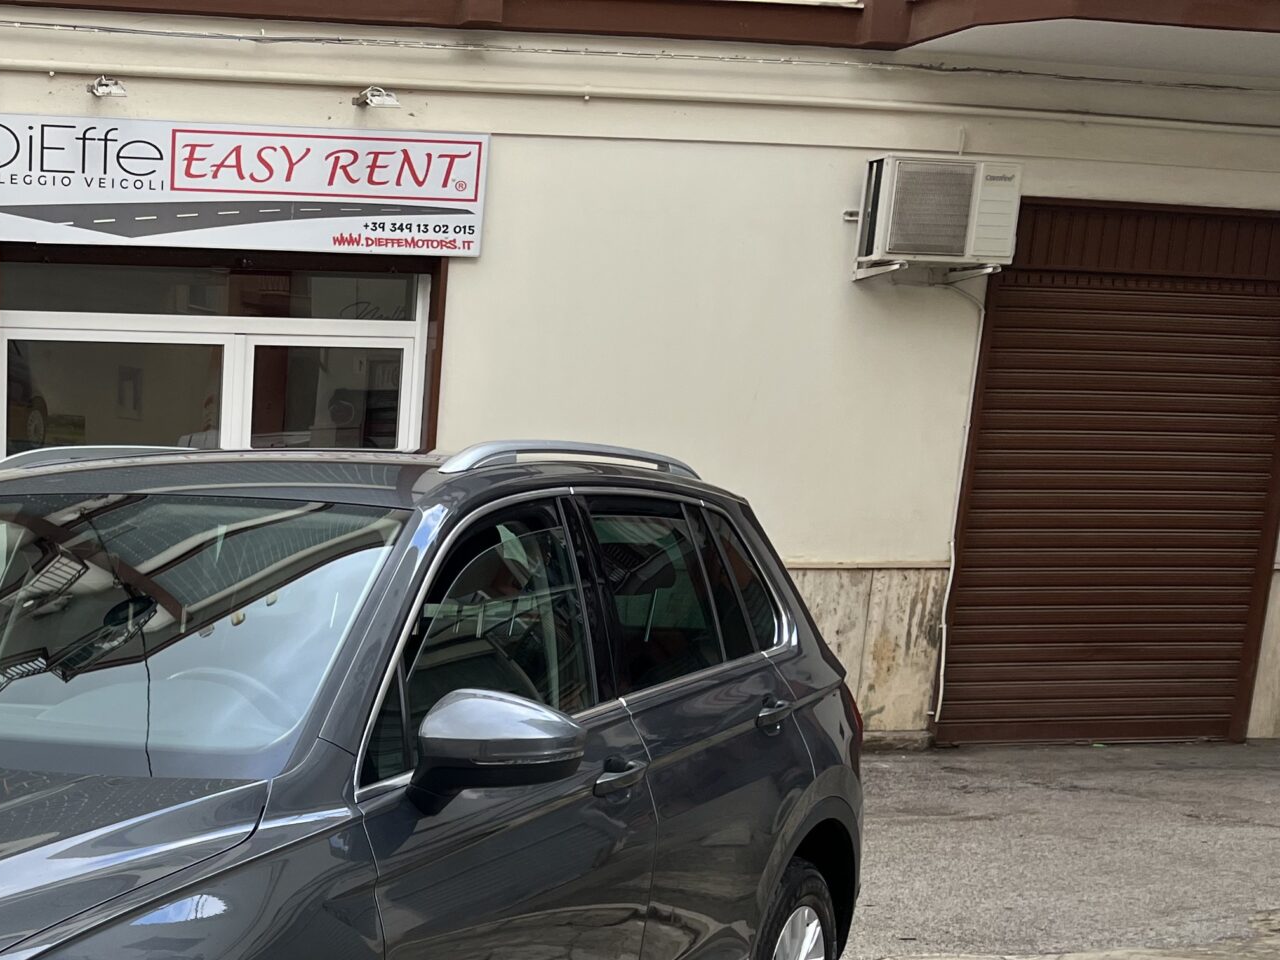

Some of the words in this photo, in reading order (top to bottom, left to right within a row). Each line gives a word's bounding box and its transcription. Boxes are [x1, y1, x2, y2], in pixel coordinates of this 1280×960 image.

[181, 142, 312, 183] EASY
[84, 176, 164, 191] VEICOLI
[363, 221, 386, 232] +39
[389, 222, 413, 233] 349
[416, 223, 429, 234] 13
[433, 224, 449, 234] 02
[453, 225, 475, 235] 015
